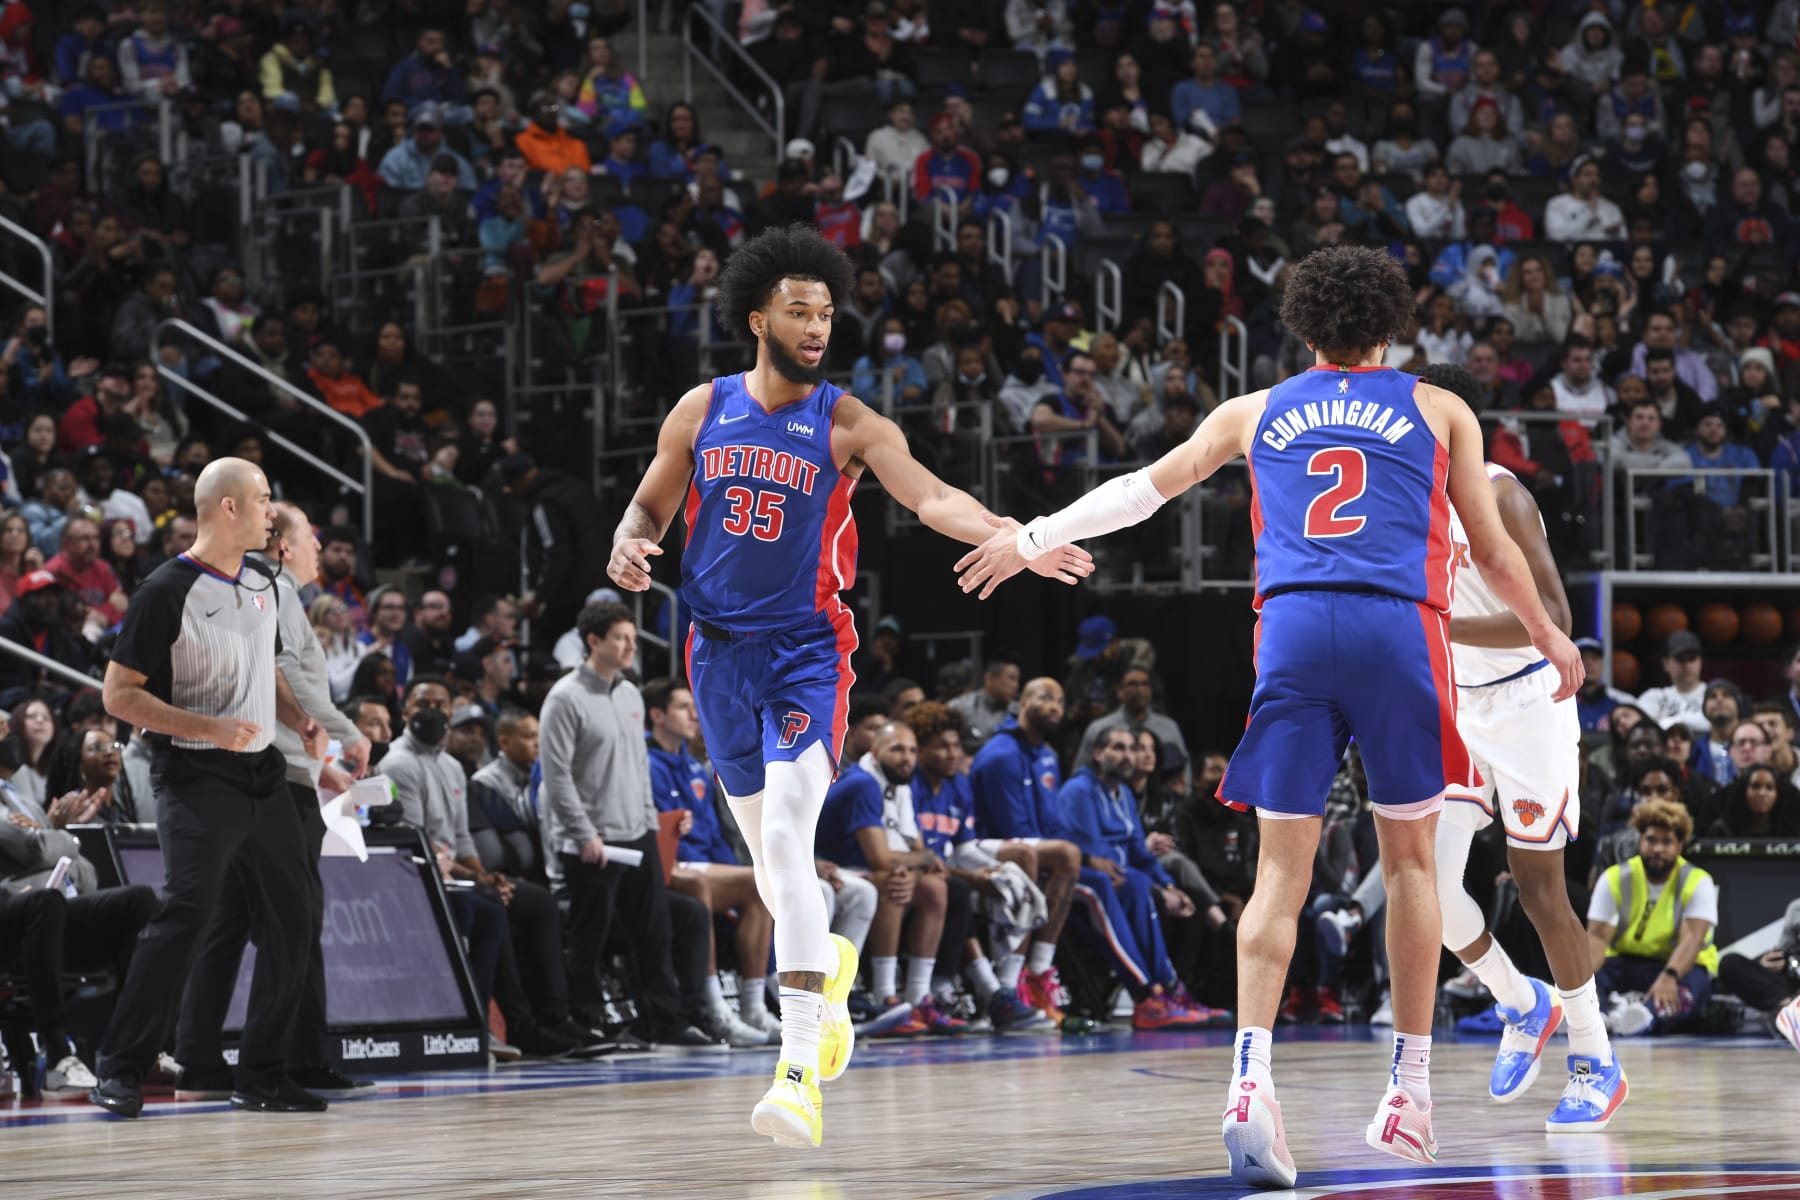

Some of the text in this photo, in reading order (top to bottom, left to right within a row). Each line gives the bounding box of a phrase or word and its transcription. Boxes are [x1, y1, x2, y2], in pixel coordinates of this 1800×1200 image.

[786, 421, 814, 437] UWM
[1262, 399, 1415, 451] CUNNINGHAM
[701, 445, 820, 496] DETROIT
[1303, 446, 1368, 538] 2
[723, 486, 786, 542] 35
